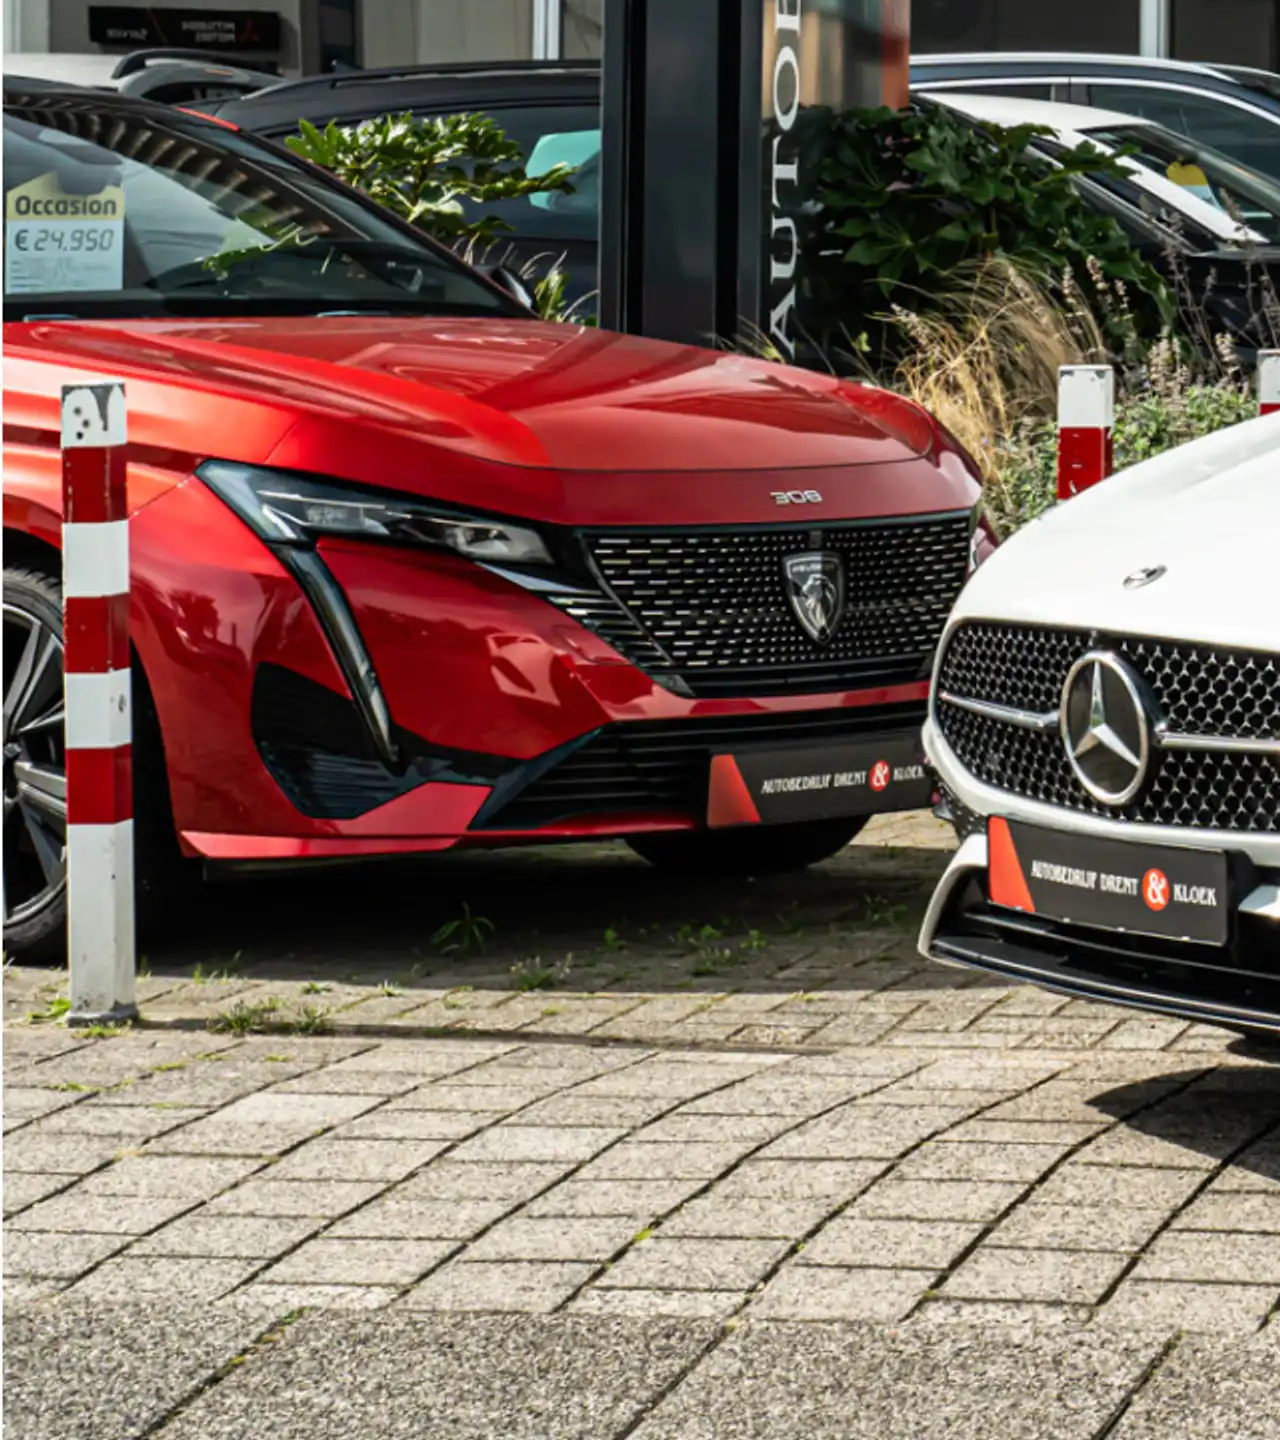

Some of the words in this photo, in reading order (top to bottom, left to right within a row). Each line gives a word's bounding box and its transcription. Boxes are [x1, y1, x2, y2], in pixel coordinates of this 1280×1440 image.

[15, 195, 117, 216] Occasion
[770, 489, 823, 505] 308
[833, 770, 867, 788] DRENT
[873, 761, 889, 787] &
[1100, 873, 1139, 896] DRENT
[1148, 871, 1166, 905] &
[1172, 883, 1217, 907] KLOEK
